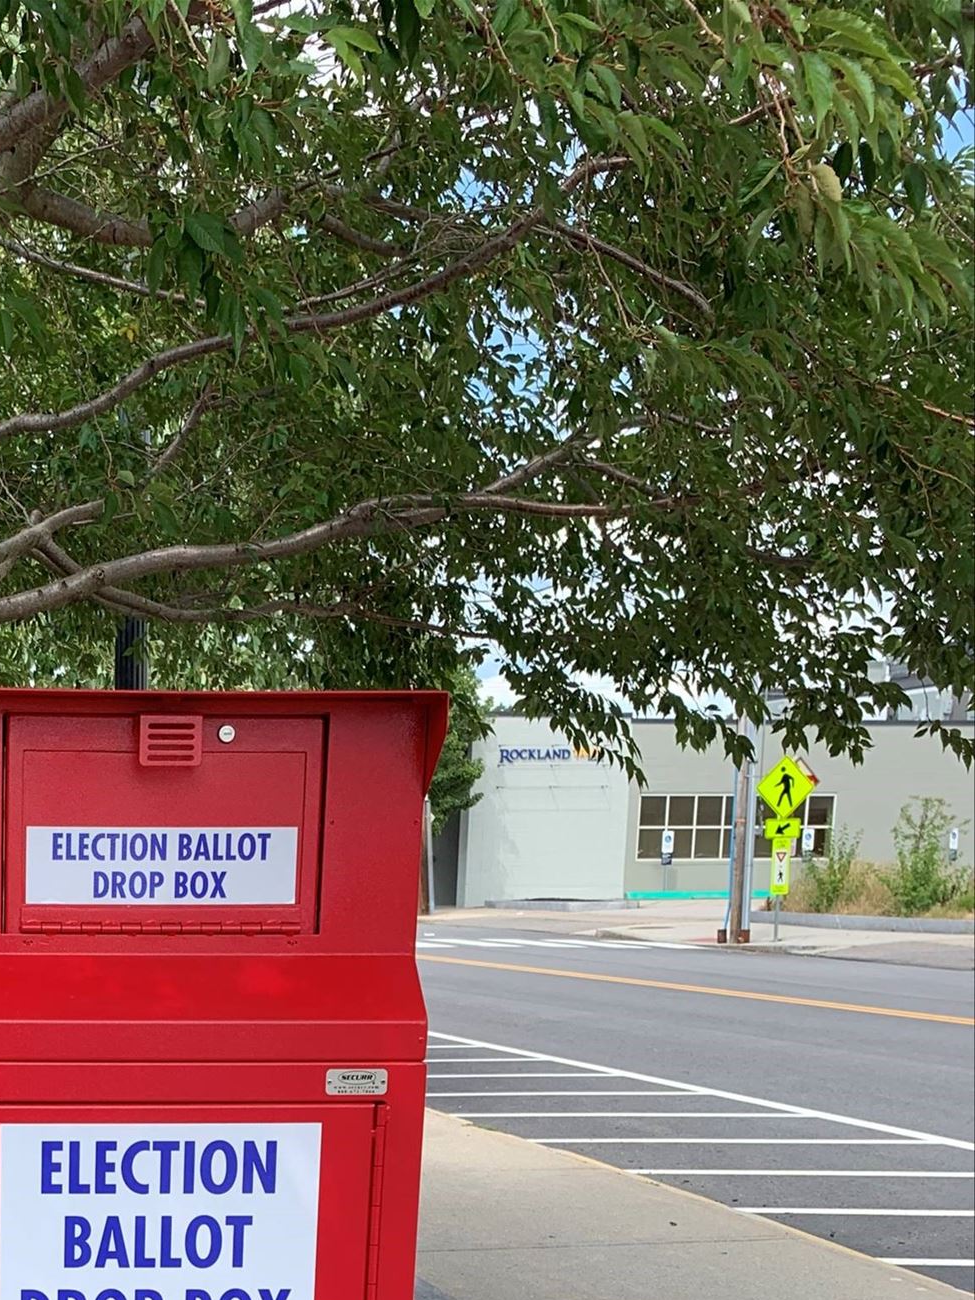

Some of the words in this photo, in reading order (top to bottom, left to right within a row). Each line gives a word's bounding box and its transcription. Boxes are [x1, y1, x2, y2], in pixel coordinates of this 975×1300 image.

[500, 749, 571, 763] ROCKLAND
[52, 833, 167, 861] ELECTION
[178, 833, 271, 861] BALLOT
[93, 871, 164, 898] DROP
[174, 871, 227, 898] BOX
[41, 1140, 277, 1195] ELECTION
[64, 1215, 253, 1268] BALLOT
